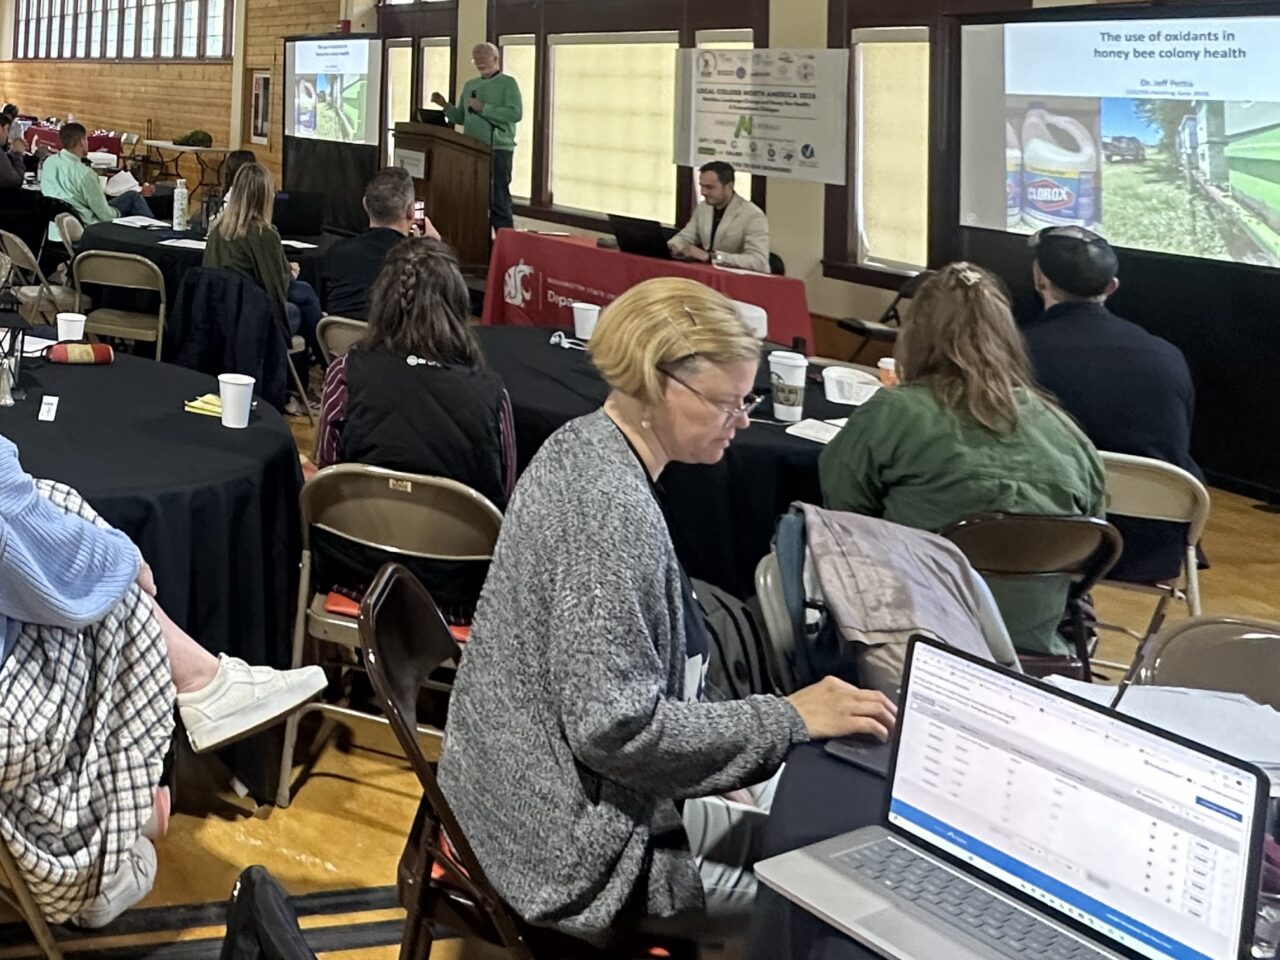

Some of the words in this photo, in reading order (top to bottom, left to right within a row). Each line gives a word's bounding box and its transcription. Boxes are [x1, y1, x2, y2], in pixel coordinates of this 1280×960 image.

[1100, 32, 1121, 42] The
[1125, 33, 1145, 42] use
[1148, 31, 1162, 42] of
[1164, 31, 1219, 42] oxidants
[1222, 30, 1235, 41] in
[1094, 48, 1130, 60] honey
[1133, 48, 1156, 58] bee
[1159, 47, 1200, 60] colony
[1204, 47, 1246, 58] health
[696, 87, 715, 95] LOCAL
[743, 89, 765, 97] NORTH
[766, 90, 798, 98] AMERICA
[1027, 186, 1071, 201] CLOROX
